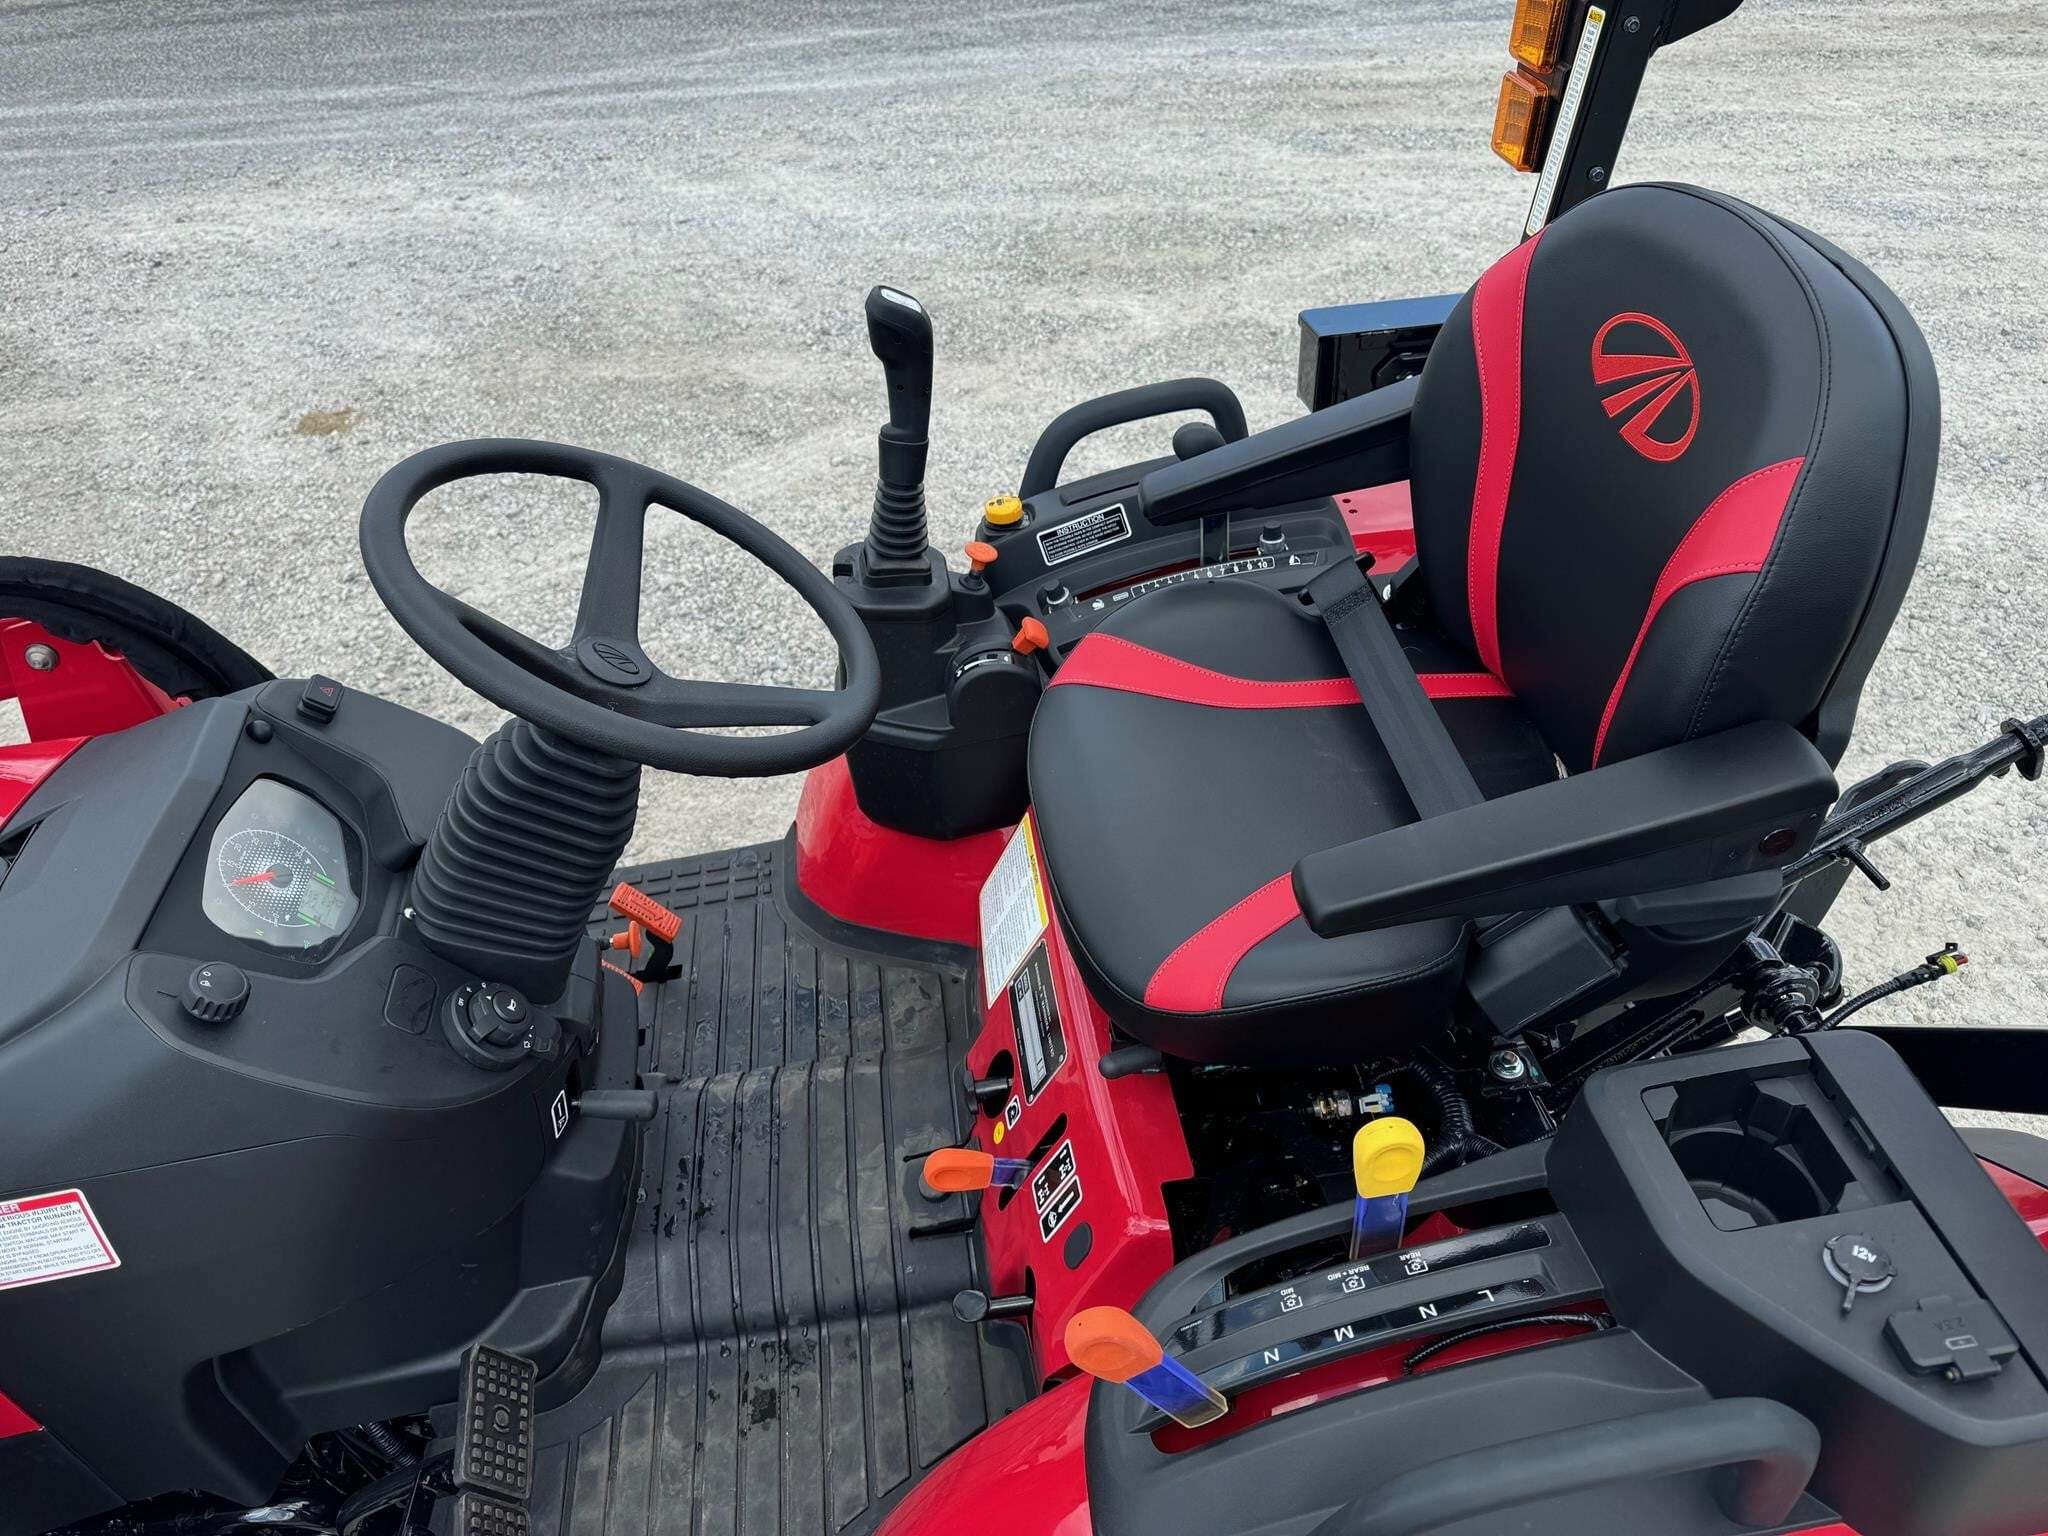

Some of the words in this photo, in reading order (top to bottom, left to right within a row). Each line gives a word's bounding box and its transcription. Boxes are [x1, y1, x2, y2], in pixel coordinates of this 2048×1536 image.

[1057, 513, 1104, 537] INSTRUCTION
[1257, 561, 1268, 569] 10
[6, 1216, 42, 1227] TRACTOR
[43, 1209, 81, 1220] RUNAWAY
[1399, 1251, 1421, 1261] REAR
[1327, 1272, 1341, 1281] MID
[1348, 1264, 1370, 1275] REAR
[1280, 1287, 1294, 1296] MID
[1477, 1289, 1495, 1303] L
[1418, 1303, 1438, 1319] N
[1335, 1325, 1355, 1343] M
[1264, 1348, 1280, 1365] N
